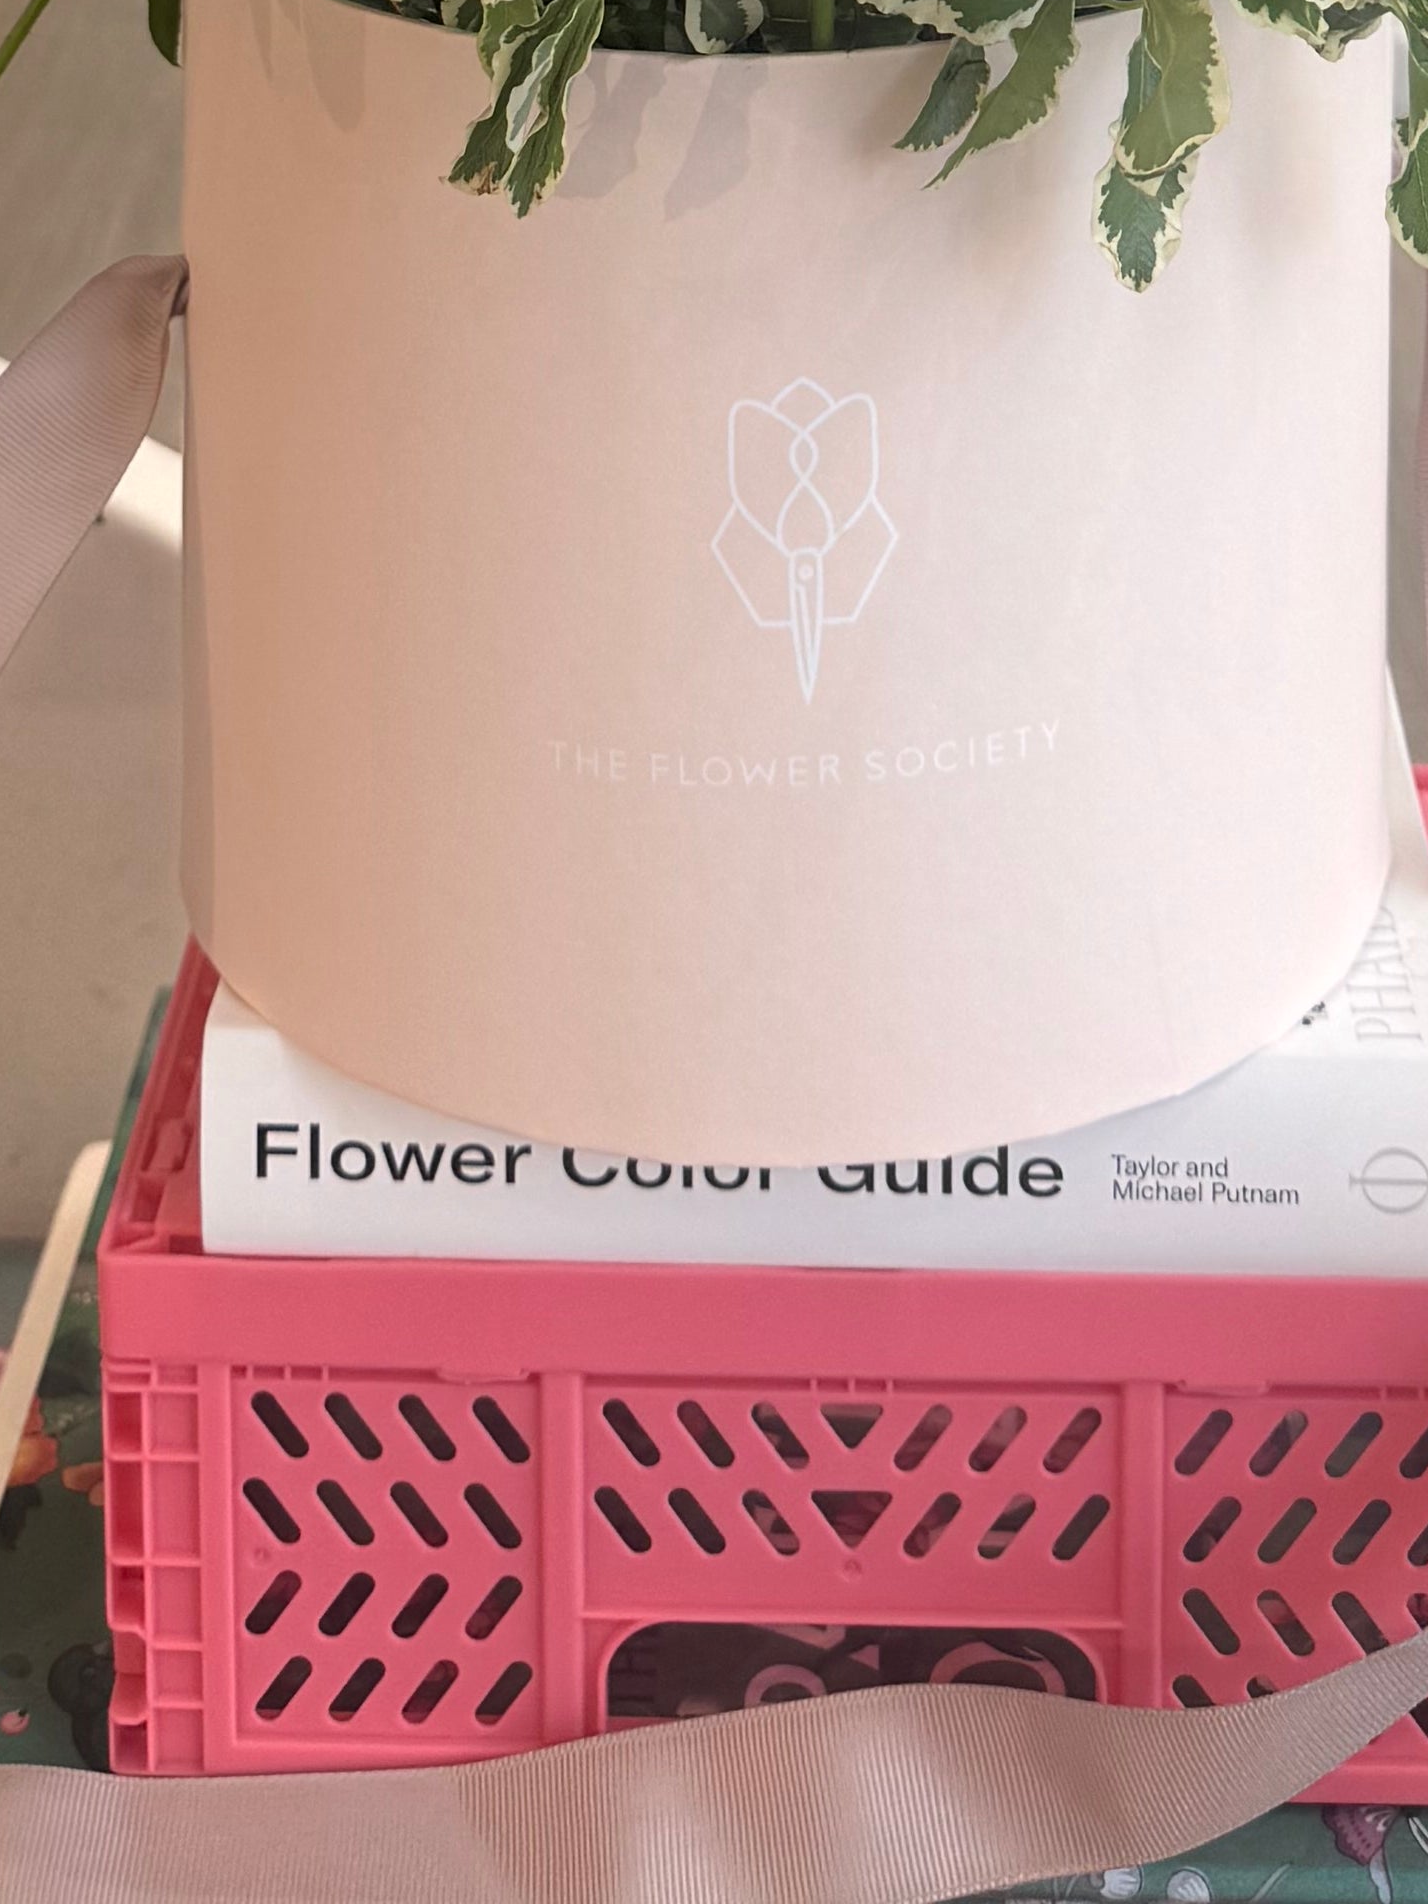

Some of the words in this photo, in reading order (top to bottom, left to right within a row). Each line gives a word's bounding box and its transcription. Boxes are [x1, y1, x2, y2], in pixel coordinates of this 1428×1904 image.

[548, 740, 628, 782] THE
[649, 753, 841, 786] FLOWER
[866, 719, 1062, 782] SOCIETY
[256, 1123, 532, 1183] Flower
[1111, 1153, 1180, 1181] Taylor
[1185, 1157, 1228, 1179] and
[1112, 1180, 1204, 1204] Michael
[1211, 1182, 1300, 1206] Putnam
